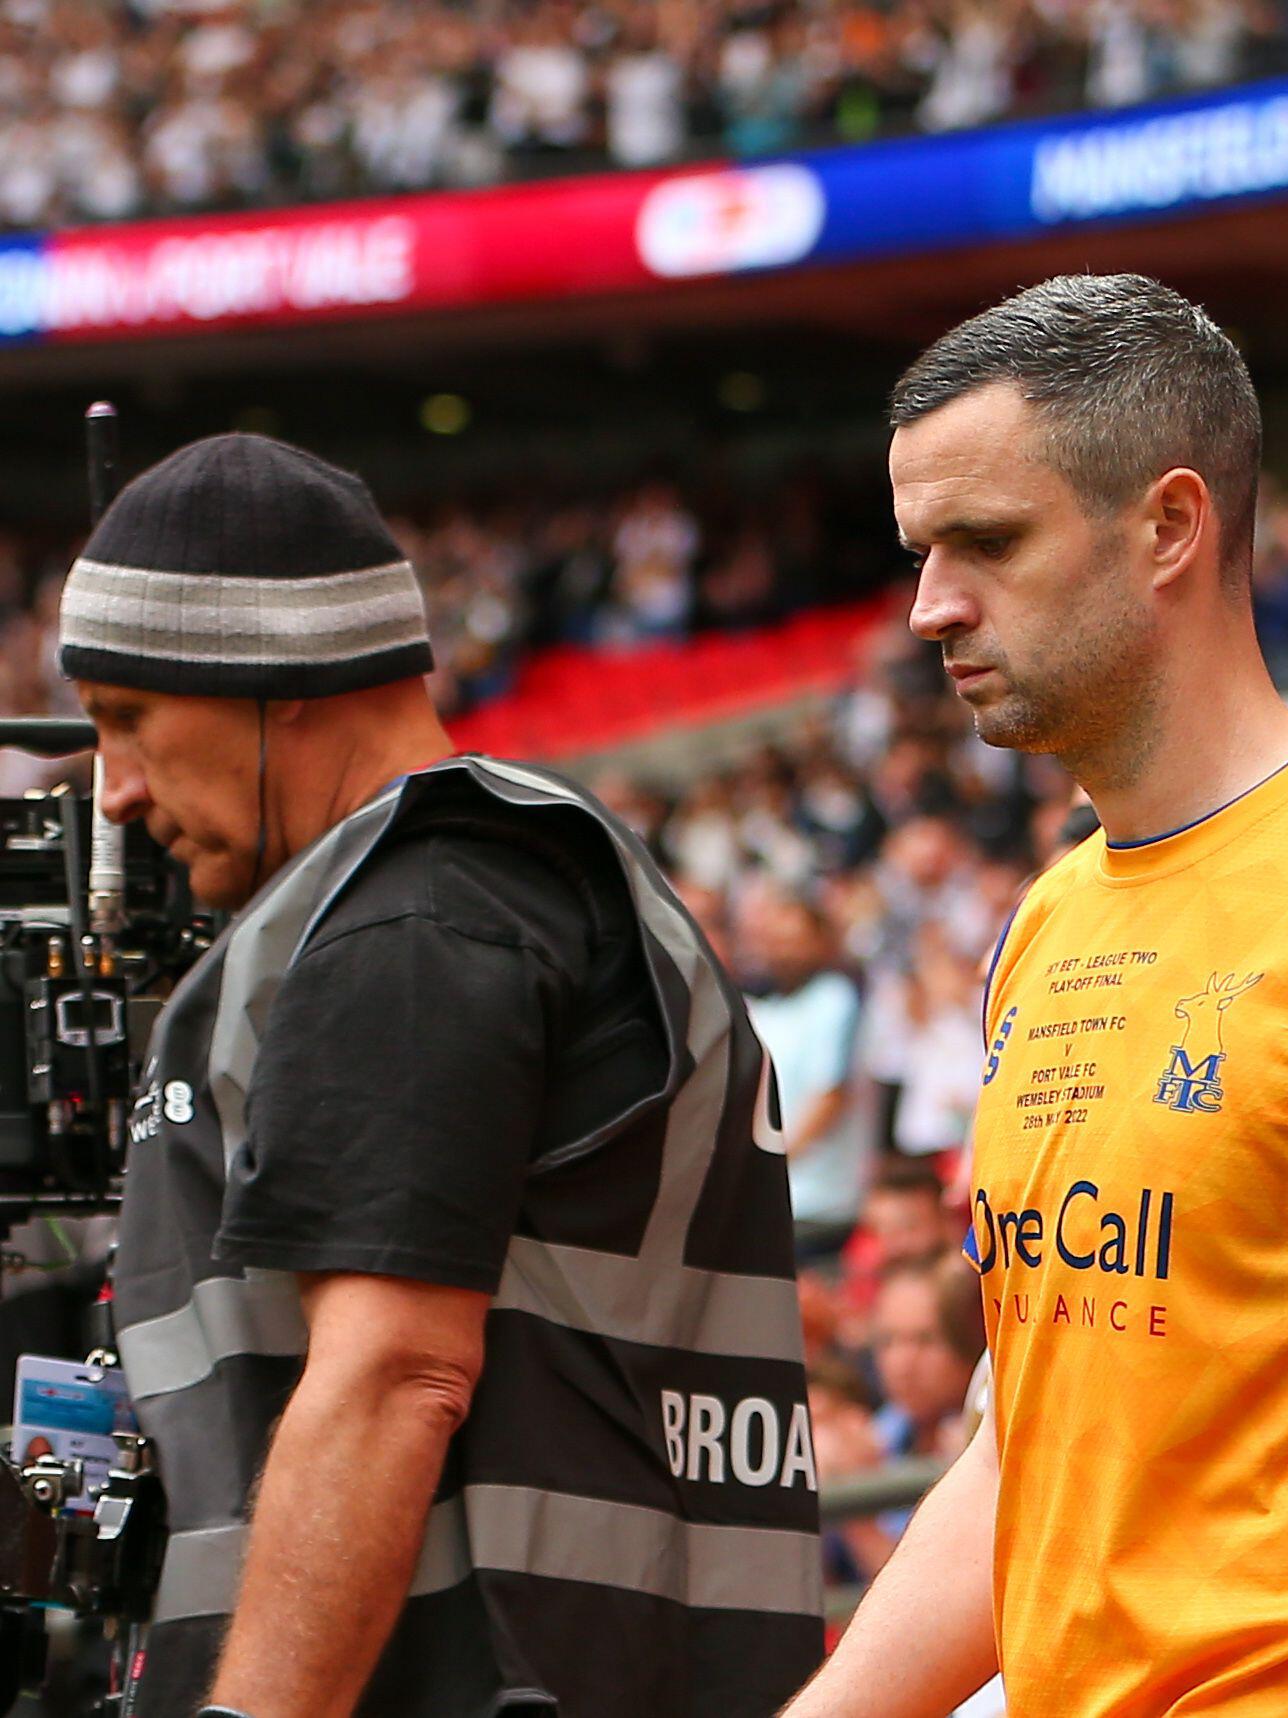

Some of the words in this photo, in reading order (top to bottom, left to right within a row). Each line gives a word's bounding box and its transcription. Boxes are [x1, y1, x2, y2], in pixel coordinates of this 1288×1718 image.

[1086, 952, 1128, 969] LEAGUE
[1129, 951, 1158, 965] TWO
[1048, 976, 1093, 994] PLAY-OFF
[1093, 974, 1124, 989] FINAL
[1027, 1021, 1078, 1041] MANSFIELD
[1080, 1018, 1108, 1034] TOWN
[1109, 1016, 1127, 1031] FC
[1031, 1068, 1057, 1084] PORT
[1059, 1064, 1081, 1081] VALE
[1082, 1062, 1097, 1077] FC
[1016, 1089, 1062, 1108] WEMBLEY
[1023, 1114, 1043, 1130] 28th
[1056, 1180, 1175, 1280] Call
